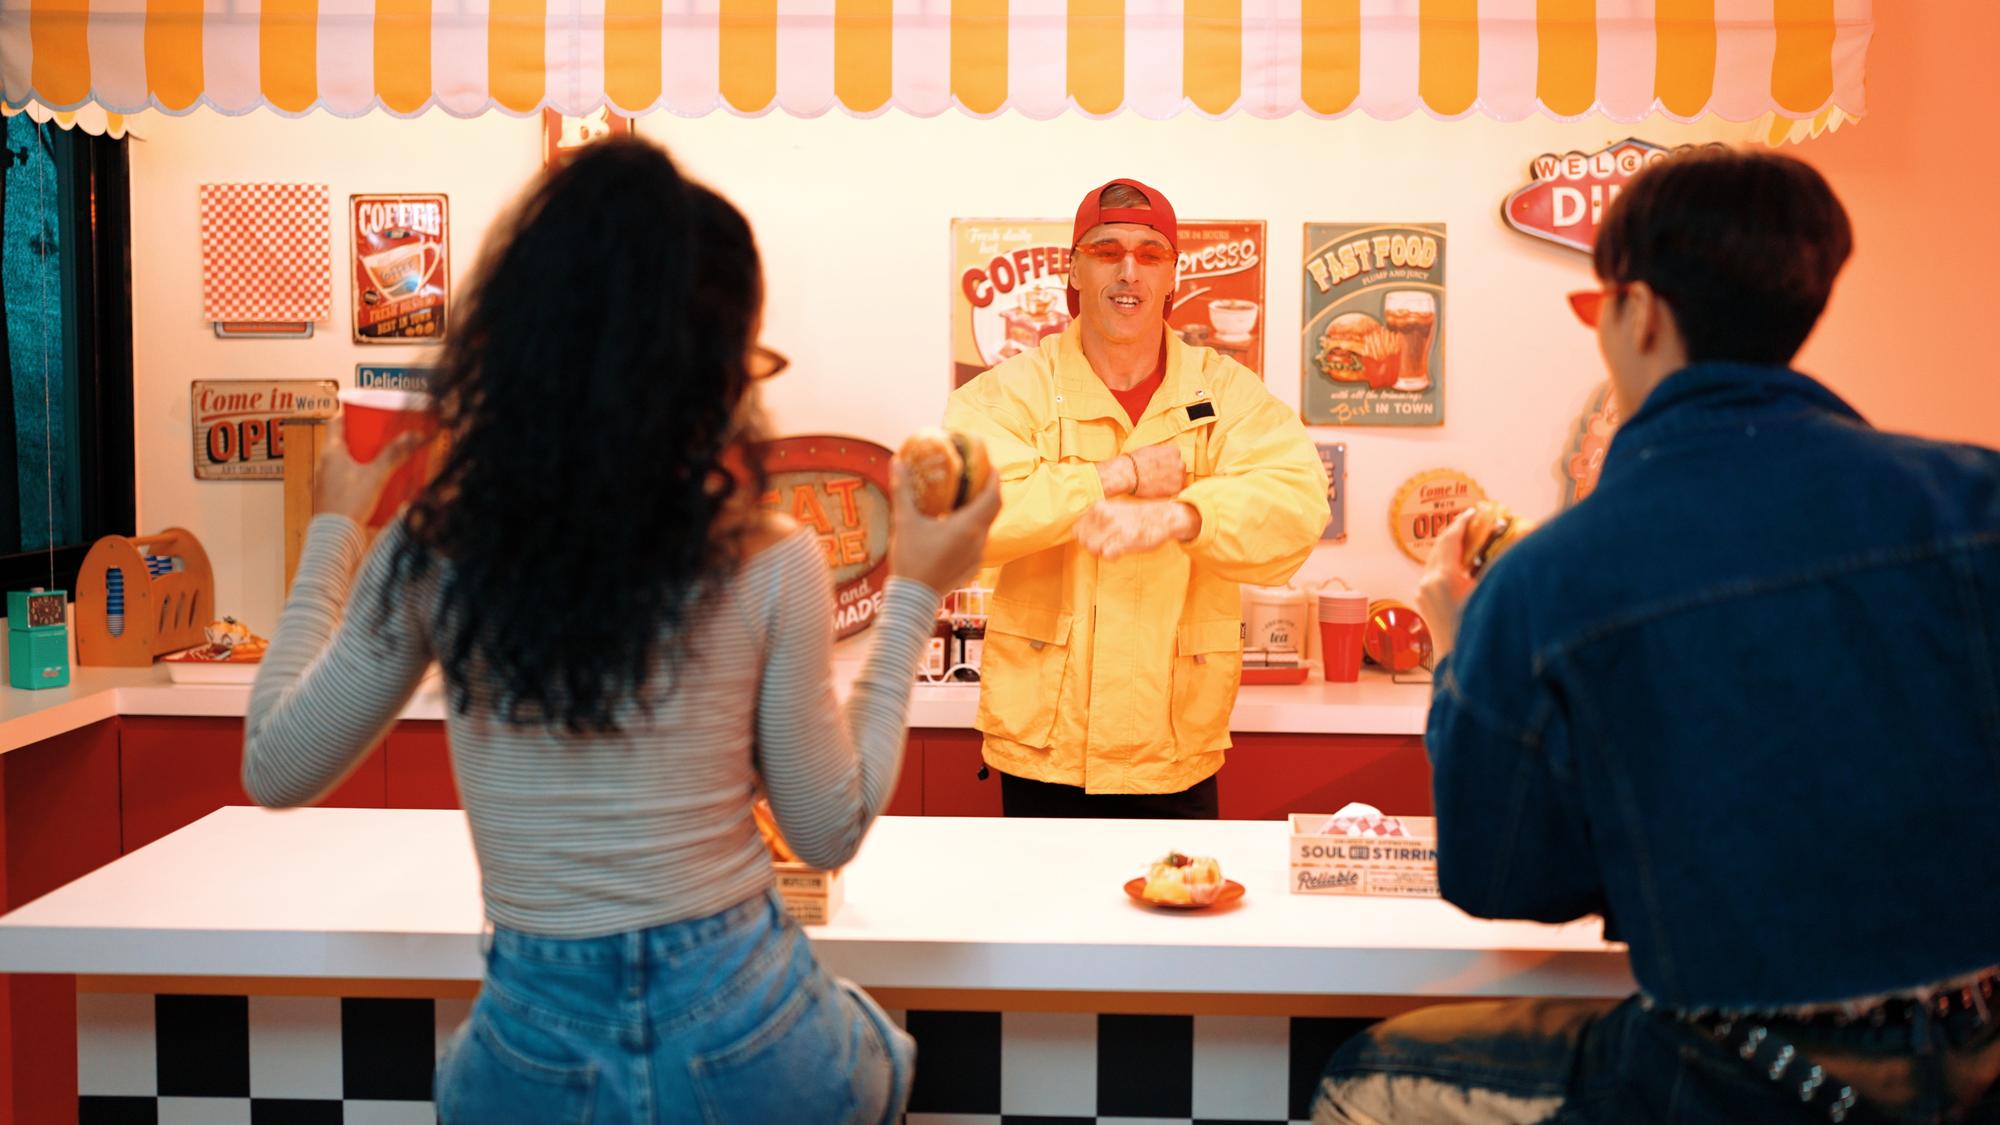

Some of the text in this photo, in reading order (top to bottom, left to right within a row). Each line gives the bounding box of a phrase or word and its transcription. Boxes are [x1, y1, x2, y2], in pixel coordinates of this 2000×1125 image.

[962, 247, 1071, 308] COFFEE
[1175, 239, 1256, 292] presso
[1307, 235, 1438, 293] FAST FOOD
[1389, 271, 1406, 279] AND
[200, 388, 263, 412] Come
[270, 388, 293, 411] in
[1375, 403, 1389, 414] IN
[1393, 403, 1433, 414] TOWN
[207, 418, 284, 464] OPE
[817, 531, 867, 568] RE
[1301, 846, 1345, 859] SOUL
[1373, 847, 1437, 861] STIRRIN
[1298, 870, 1359, 890] Reliable
